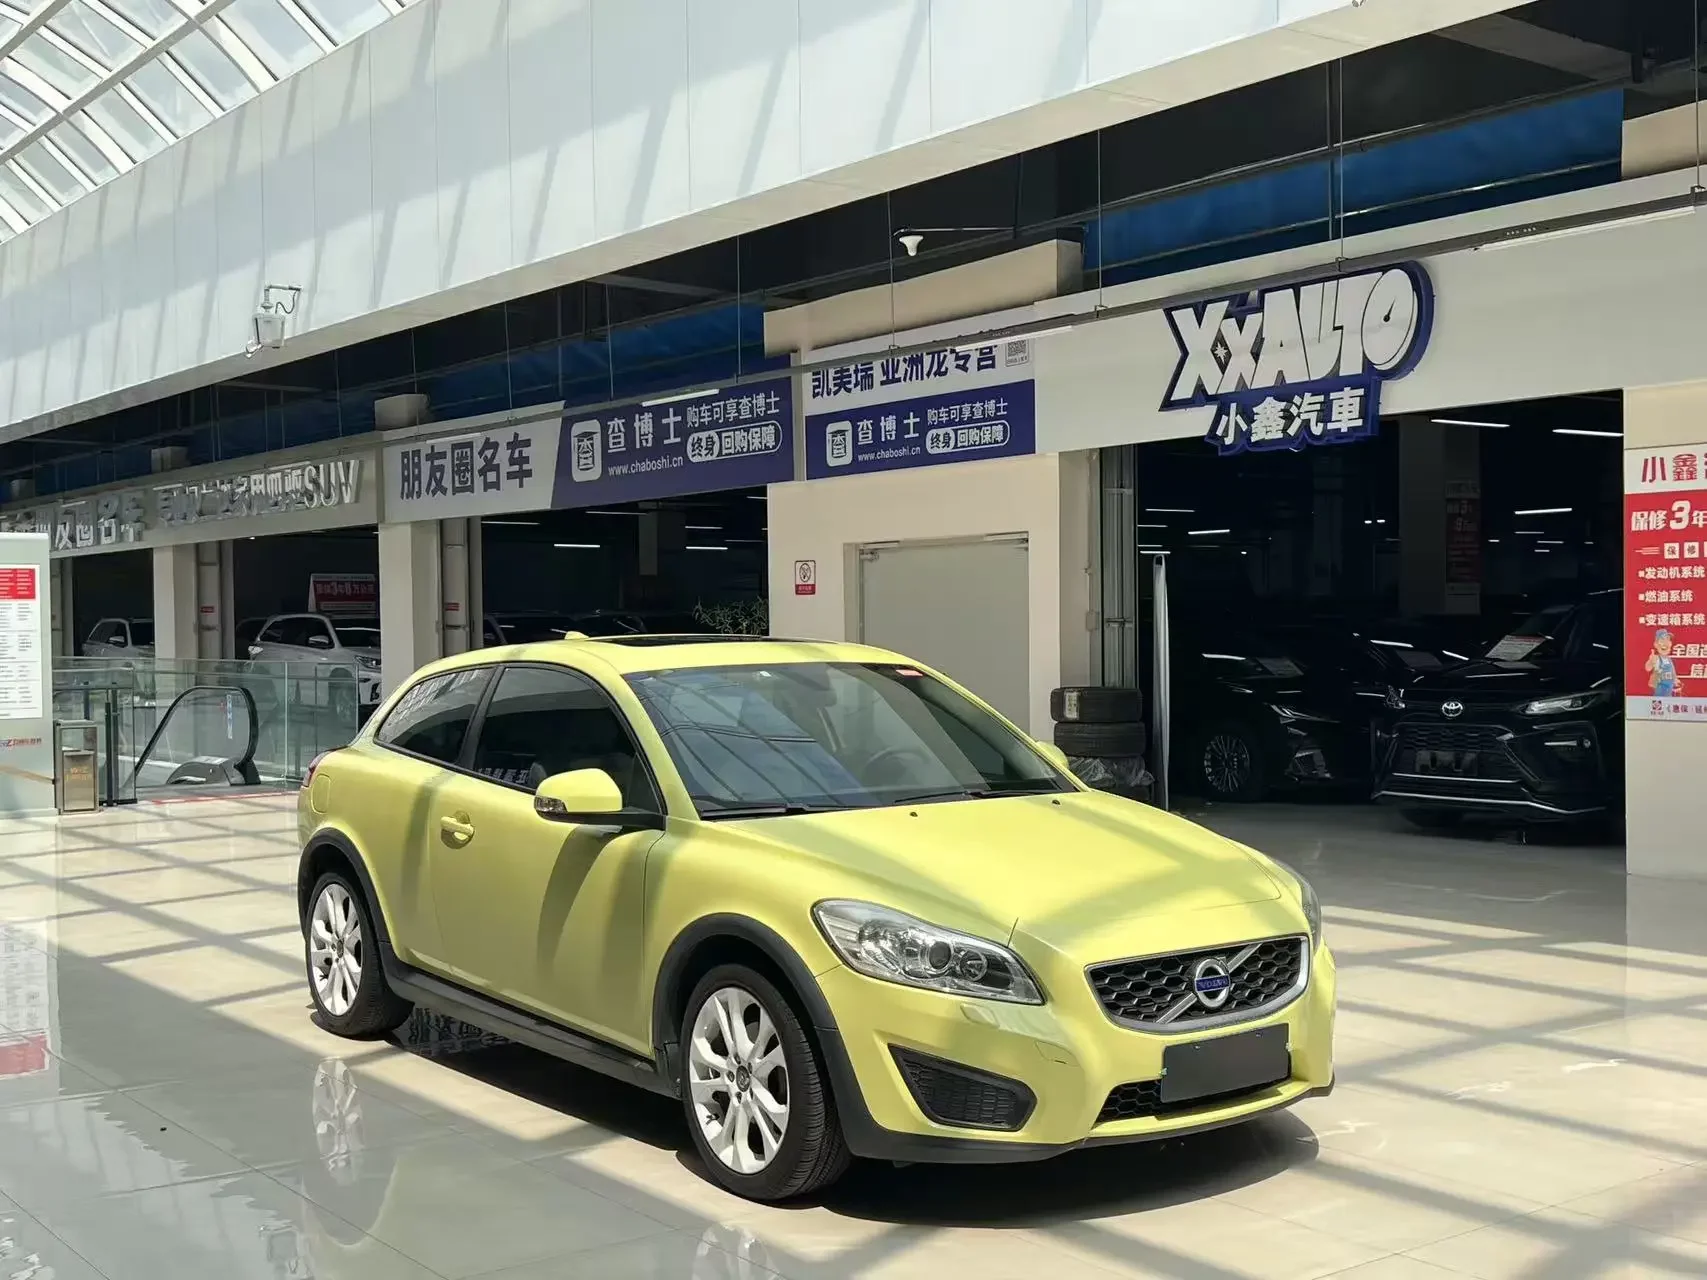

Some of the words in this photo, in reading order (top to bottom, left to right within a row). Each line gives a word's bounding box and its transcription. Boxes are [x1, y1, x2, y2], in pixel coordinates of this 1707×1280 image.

[686, 391, 780, 428] 购车可享查博士
[927, 398, 1009, 425] 购车可享查博士
[1215, 386, 1365, 446] 小鑫汽車
[857, 445, 921, 462] www.chaboshi.cn
[400, 432, 533, 500] 朋友圈名车
[608, 455, 684, 477] www.chaboshi.cn
[1641, 453, 1707, 483] 小鑫
[1644, 566, 1705, 580] 发动机系统
[1644, 590, 1694, 603] 燃油系统
[1644, 613, 1705, 626] 变速箱系统
[1198, 977, 1229, 989] VOLVO
